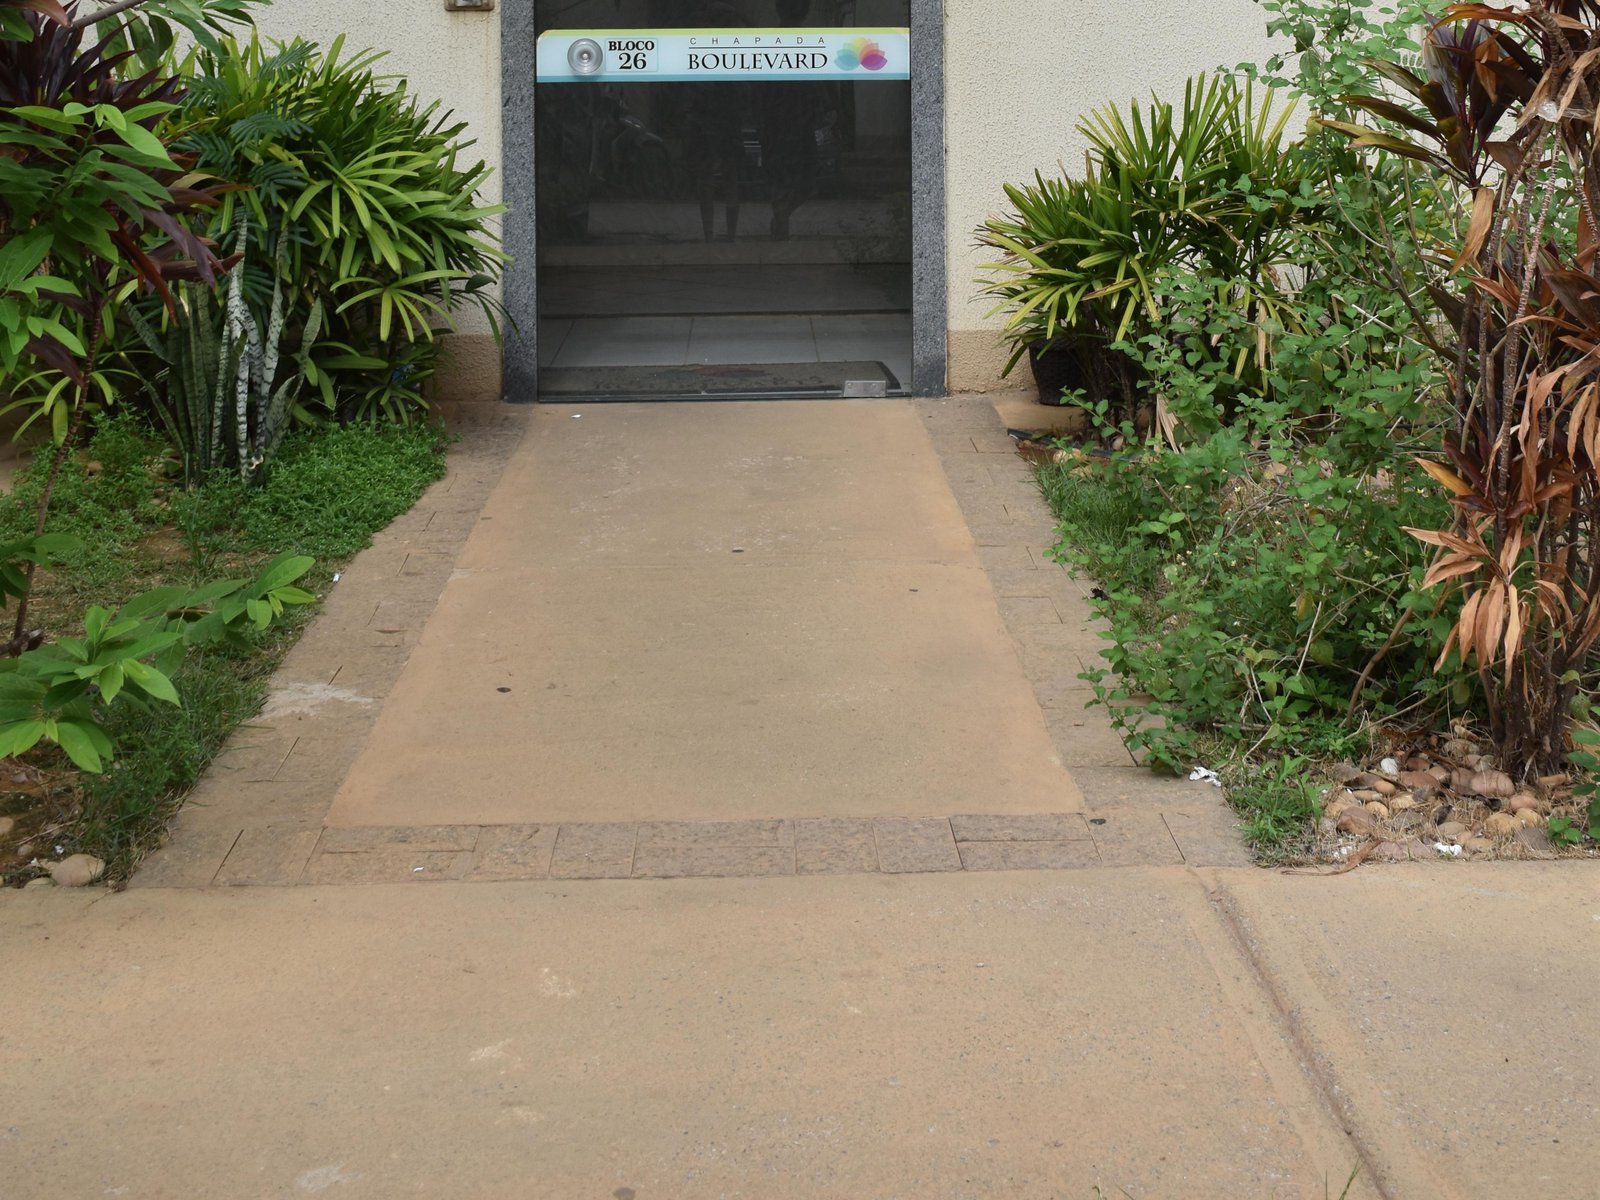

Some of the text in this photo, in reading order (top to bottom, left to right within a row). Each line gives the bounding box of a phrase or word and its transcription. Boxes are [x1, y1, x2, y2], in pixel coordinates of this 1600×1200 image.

[608, 40, 655, 51] BLOCO
[689, 37, 825, 45] CHAPADA
[618, 52, 648, 70] 26
[687, 53, 828, 70] BOULEVARD
